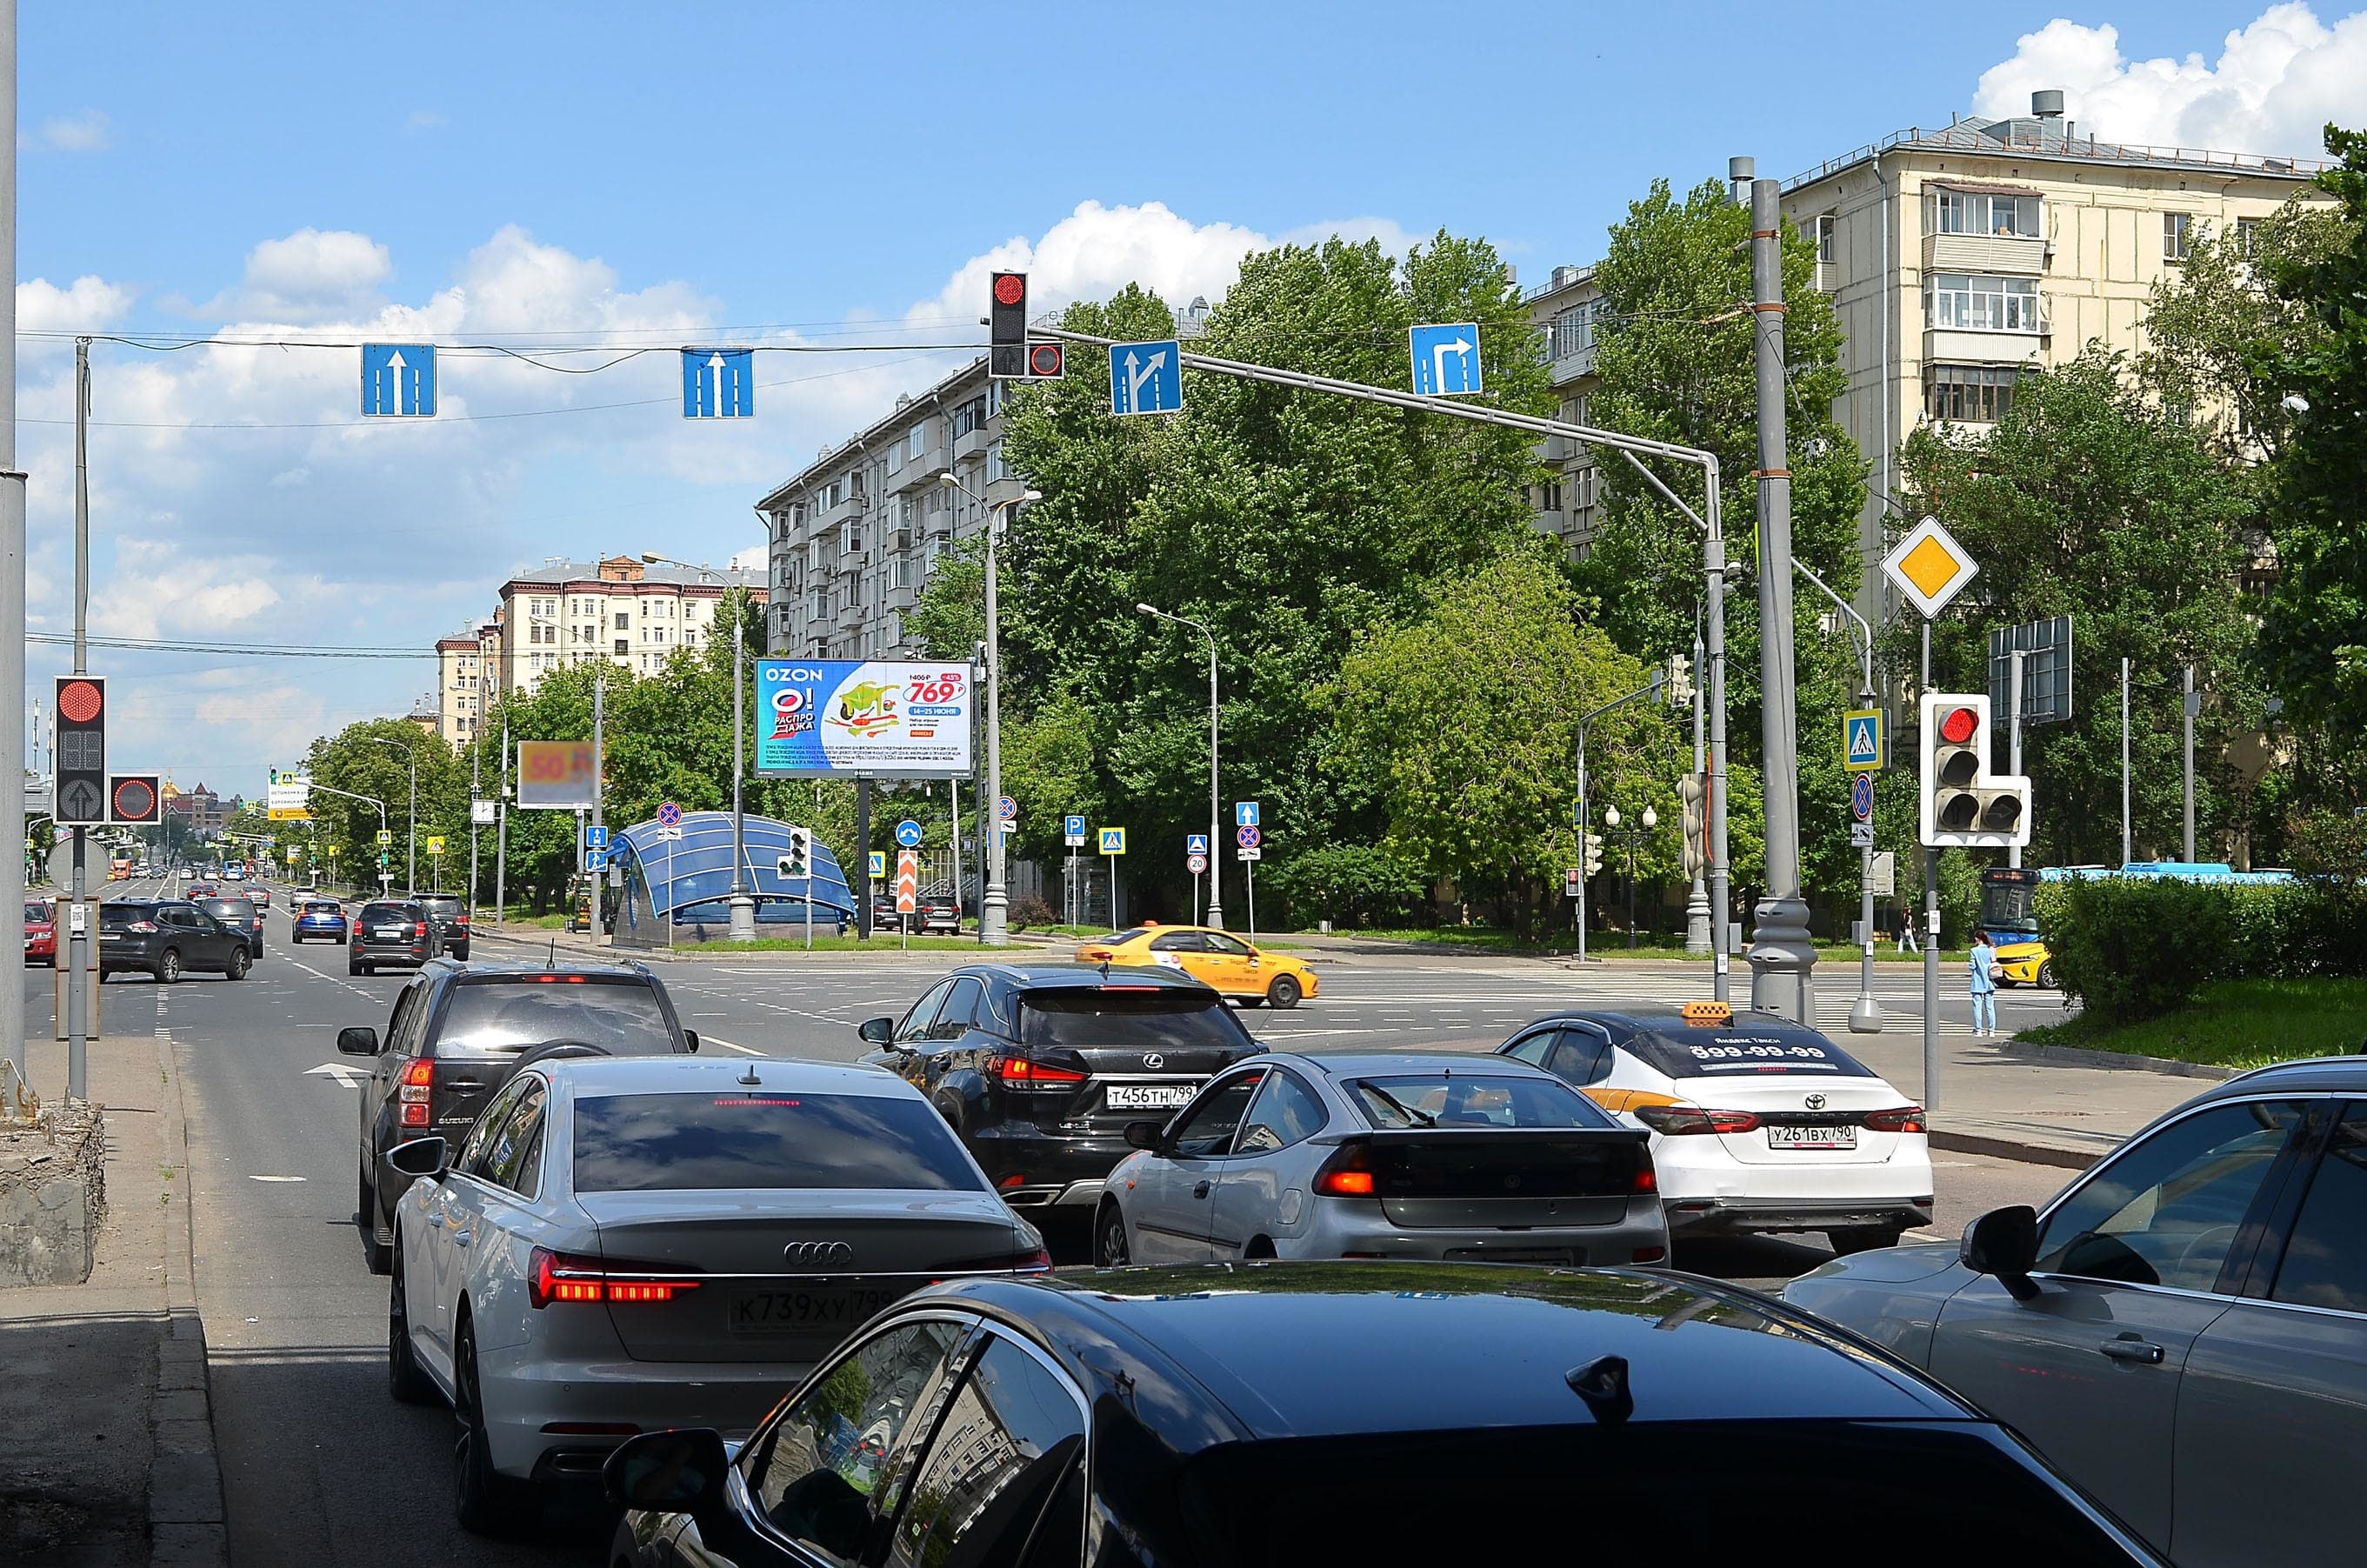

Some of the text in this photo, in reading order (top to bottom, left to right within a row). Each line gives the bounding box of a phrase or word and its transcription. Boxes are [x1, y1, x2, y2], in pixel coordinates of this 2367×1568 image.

[765, 668, 823, 683] OZON
[910, 682, 955, 704] 769
[774, 712, 815, 725] РАСПРО
[775, 722, 815, 733] ДАЖА
[1070, 818, 1080, 833] P
[1690, 1045, 1826, 1059] 999-99-99
[1112, 1086, 1193, 1103] Т456ТН 799
[1774, 1125, 1829, 1141] У261ВХ
[739, 1293, 846, 1321] К739ХУ
